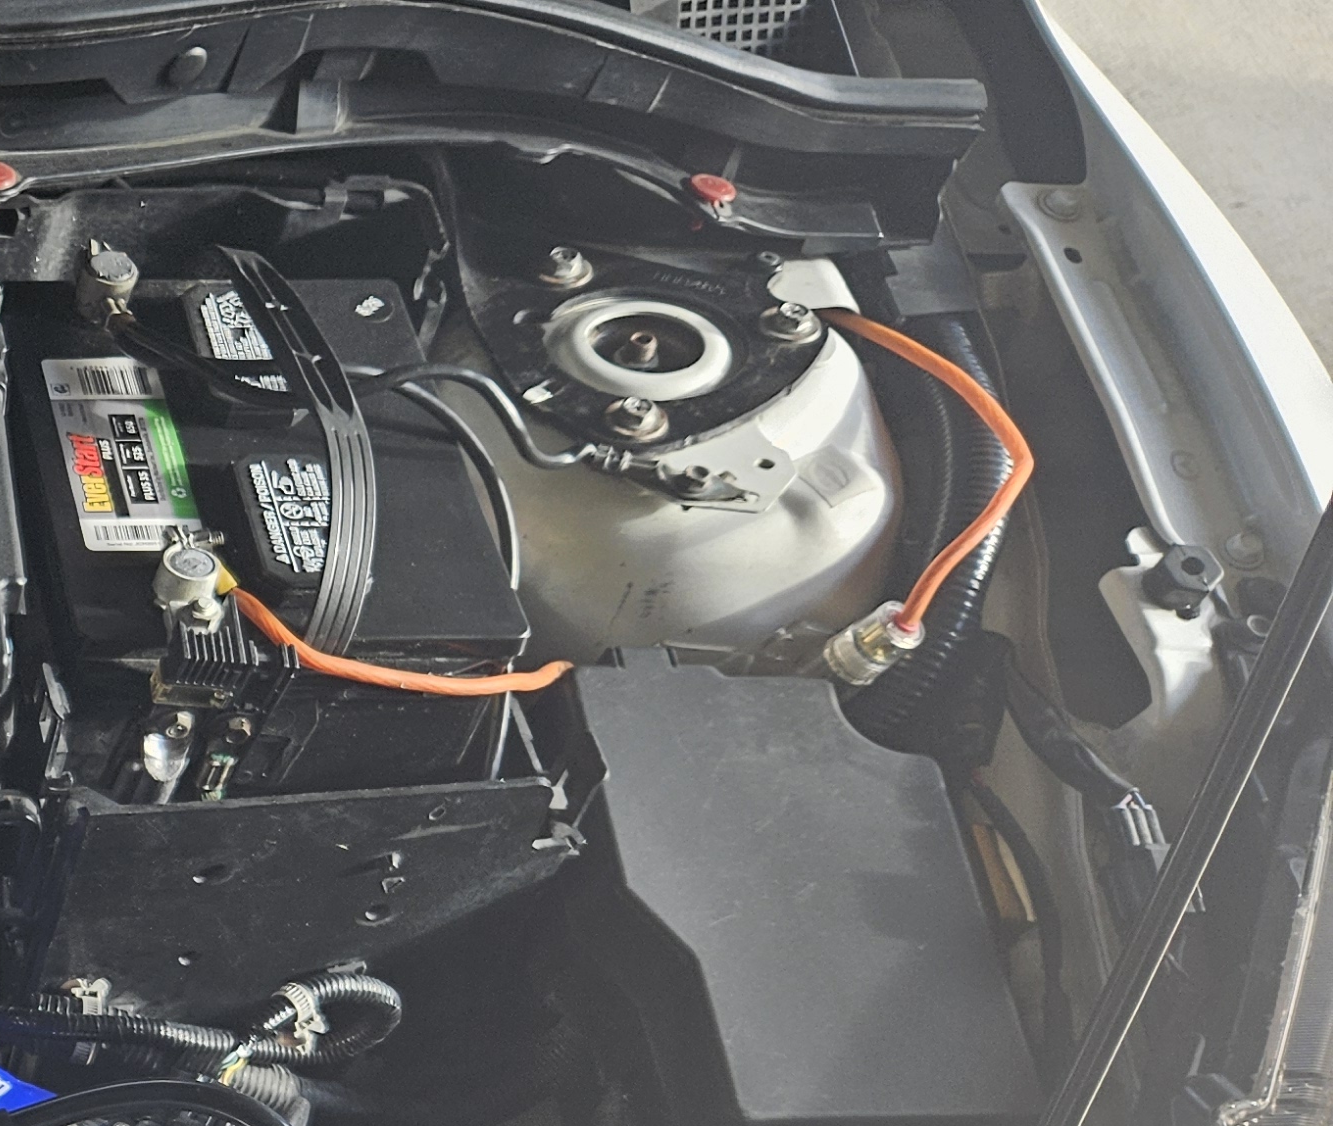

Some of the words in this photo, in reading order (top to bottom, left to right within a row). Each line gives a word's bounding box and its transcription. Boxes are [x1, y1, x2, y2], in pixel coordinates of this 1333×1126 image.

[98, 439, 113, 461] PLUS
[68, 432, 113, 513] EverStart
[139, 481, 155, 499] PLUS
[249, 461, 271, 504] POISON
[262, 507, 287, 555] DANGER
